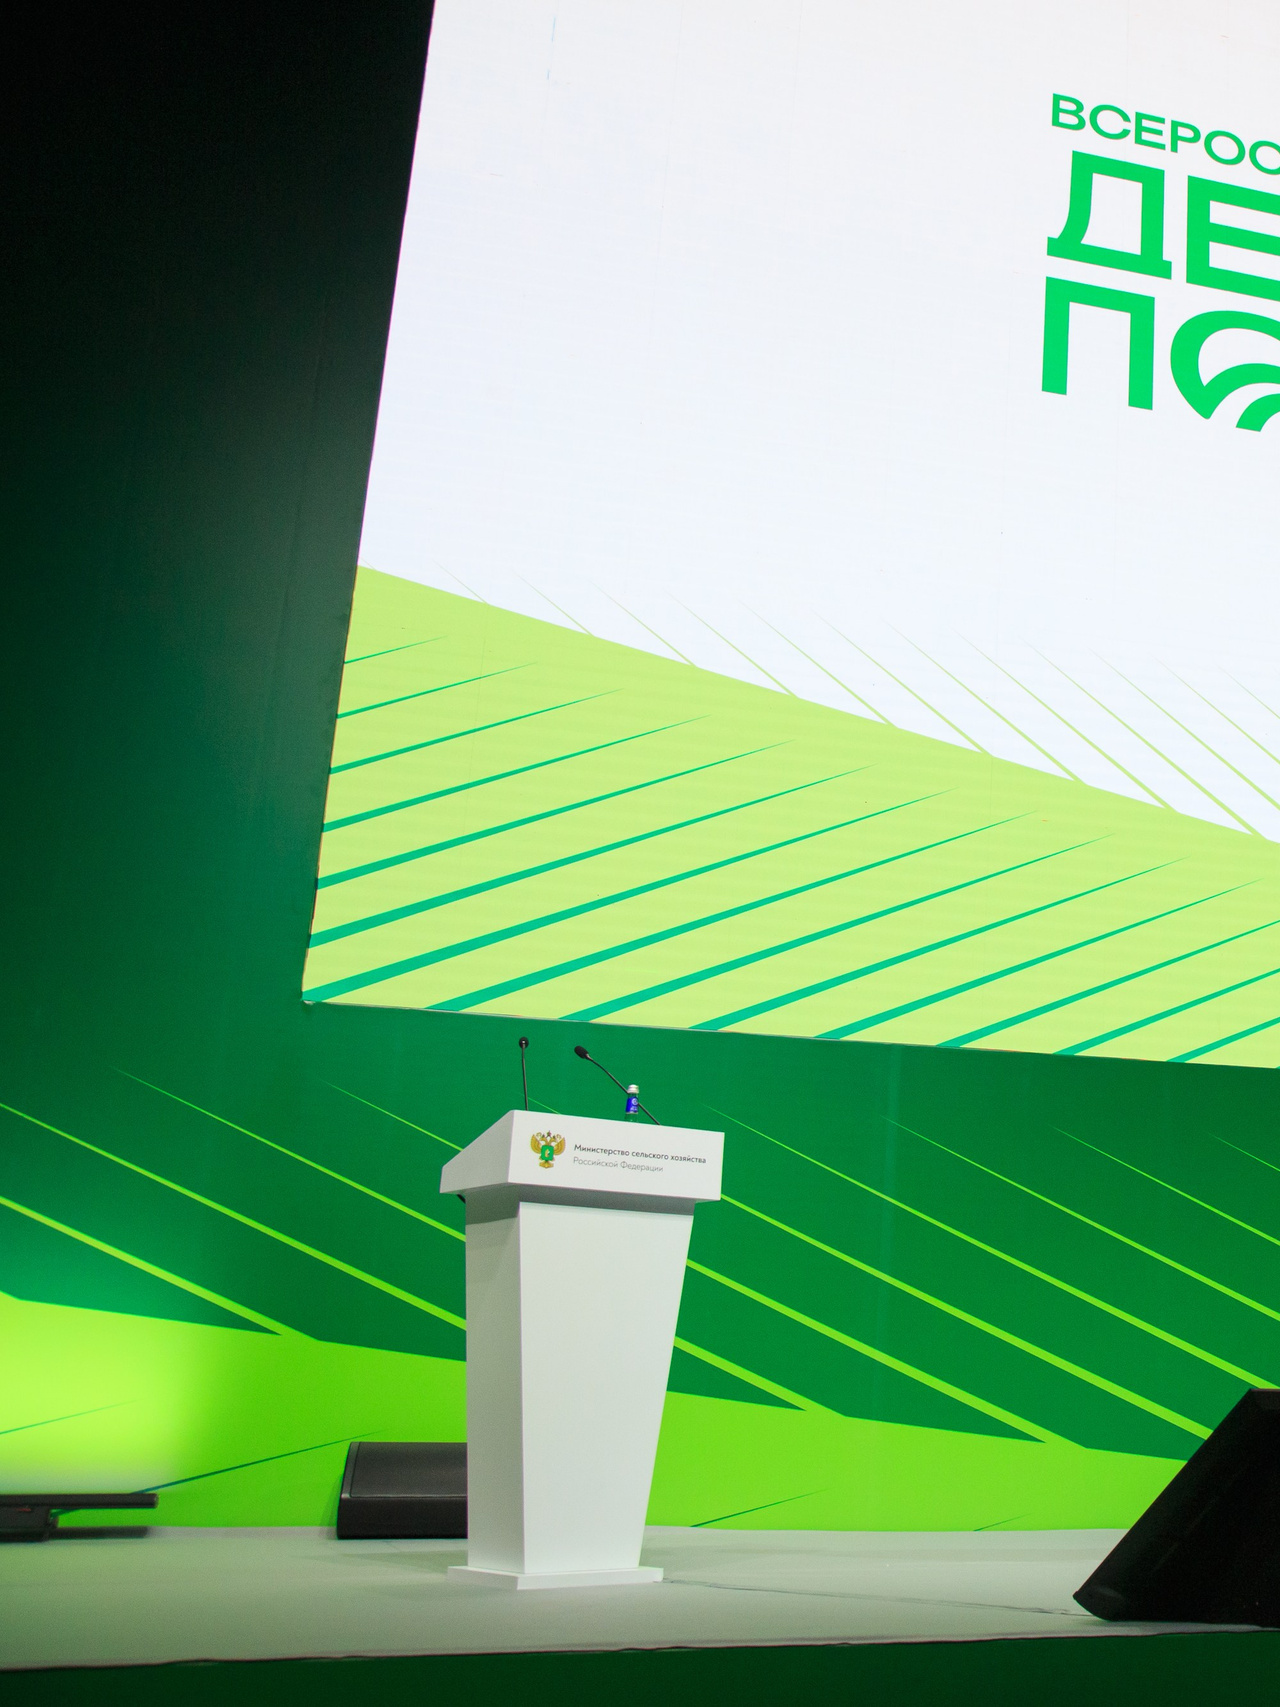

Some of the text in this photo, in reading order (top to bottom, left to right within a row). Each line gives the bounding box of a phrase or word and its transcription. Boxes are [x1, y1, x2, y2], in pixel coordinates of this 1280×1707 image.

[573, 1144, 707, 1164] Министерство сельского хозяйства
[573, 1156, 664, 1172] Российской Федерации
